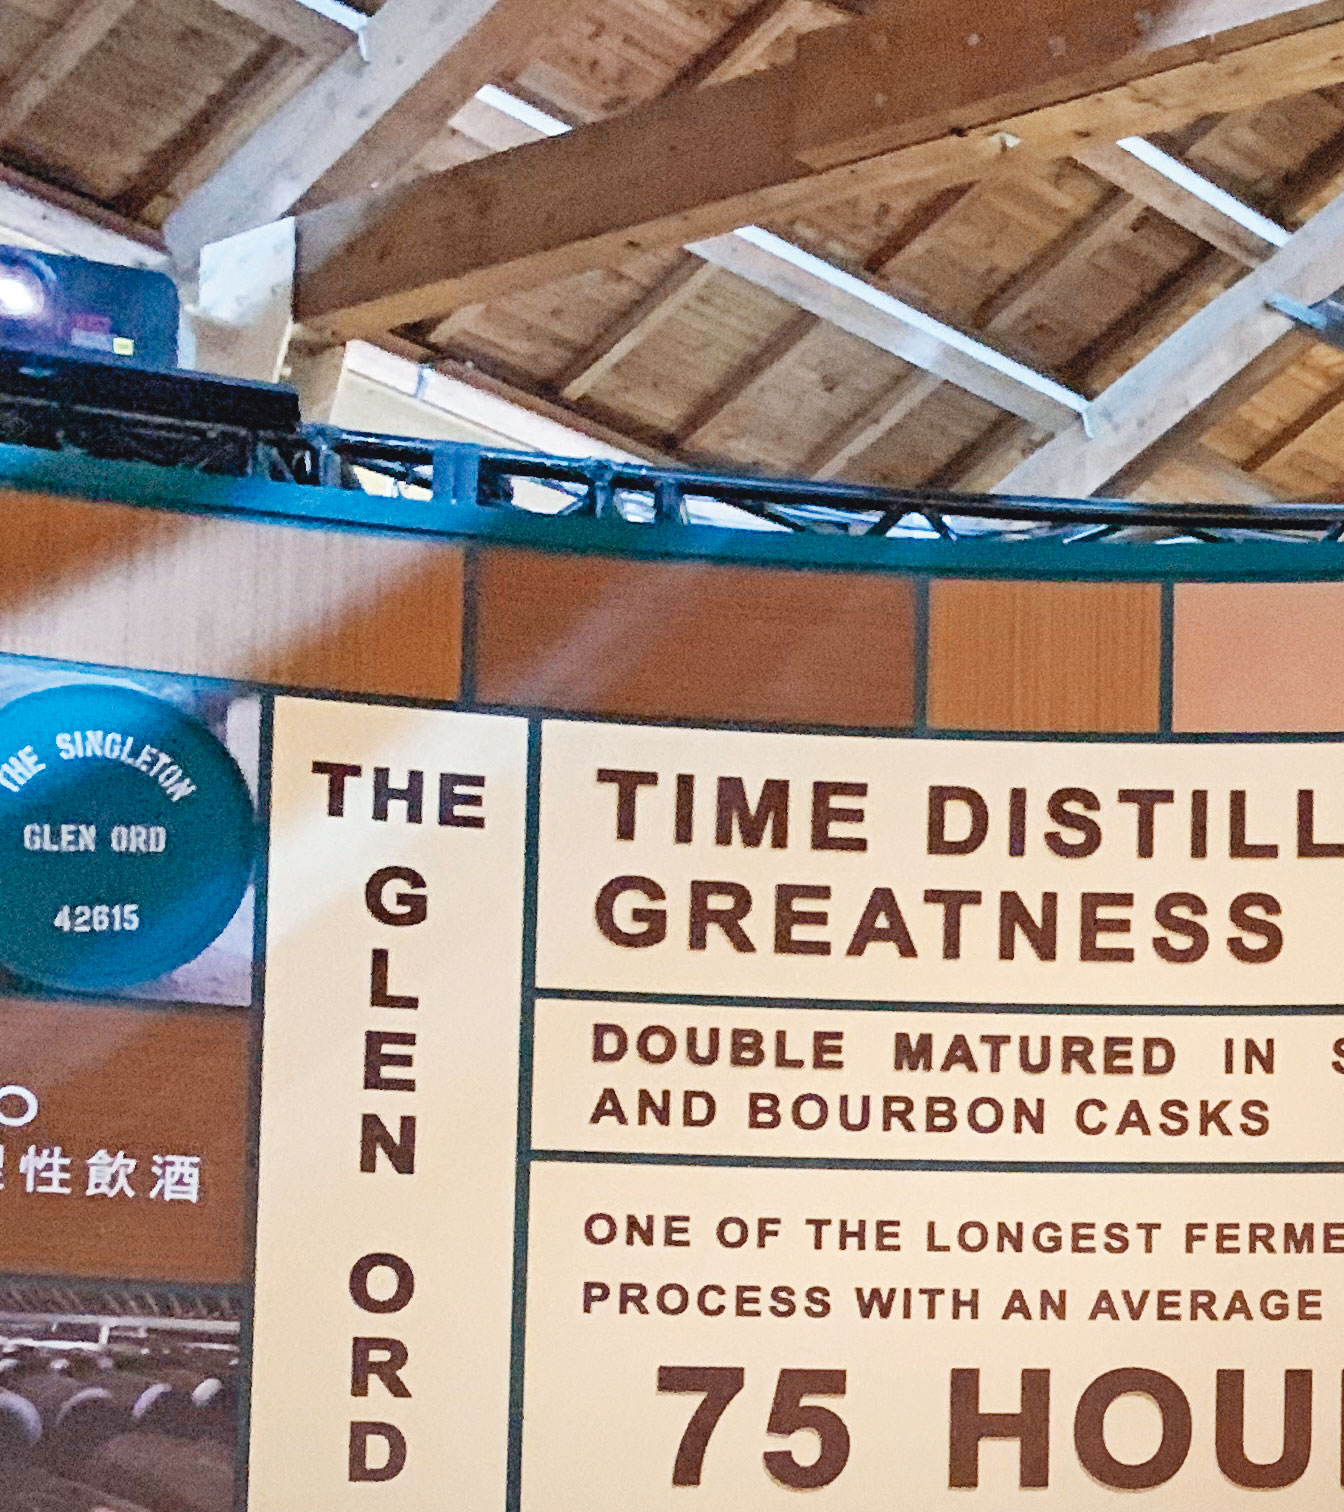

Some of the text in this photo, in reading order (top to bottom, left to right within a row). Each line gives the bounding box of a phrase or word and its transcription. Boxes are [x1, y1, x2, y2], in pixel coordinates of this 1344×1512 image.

[0, 728, 198, 803] THE SINGLETON
[309, 760, 487, 831] THE
[22, 822, 168, 854] GLEN ORD
[595, 767, 870, 854] TIME
[52, 902, 141, 934] 42615
[593, 874, 1285, 965] GREATNESS
[590, 1021, 845, 1071] DOUBLE
[892, 1031, 1177, 1077] MATURED
[1222, 1036, 1277, 1076] IN
[588, 1086, 1271, 1138] AND BOURBON CASKS
[0, 1143, 202, 1204] 性飲酒
[347, 864, 430, 1484] GLEN ORD
[583, 1211, 692, 1248] ONE
[714, 1215, 783, 1250] OF
[804, 1217, 902, 1253] THE
[925, 1219, 1163, 1255] LONGEST
[581, 1280, 832, 1320] PROCESS
[853, 1285, 982, 1321] WITH
[1000, 1287, 1069, 1322] AN
[1087, 1287, 1324, 1323] AVERAGE
[655, 1364, 852, 1493] 75
